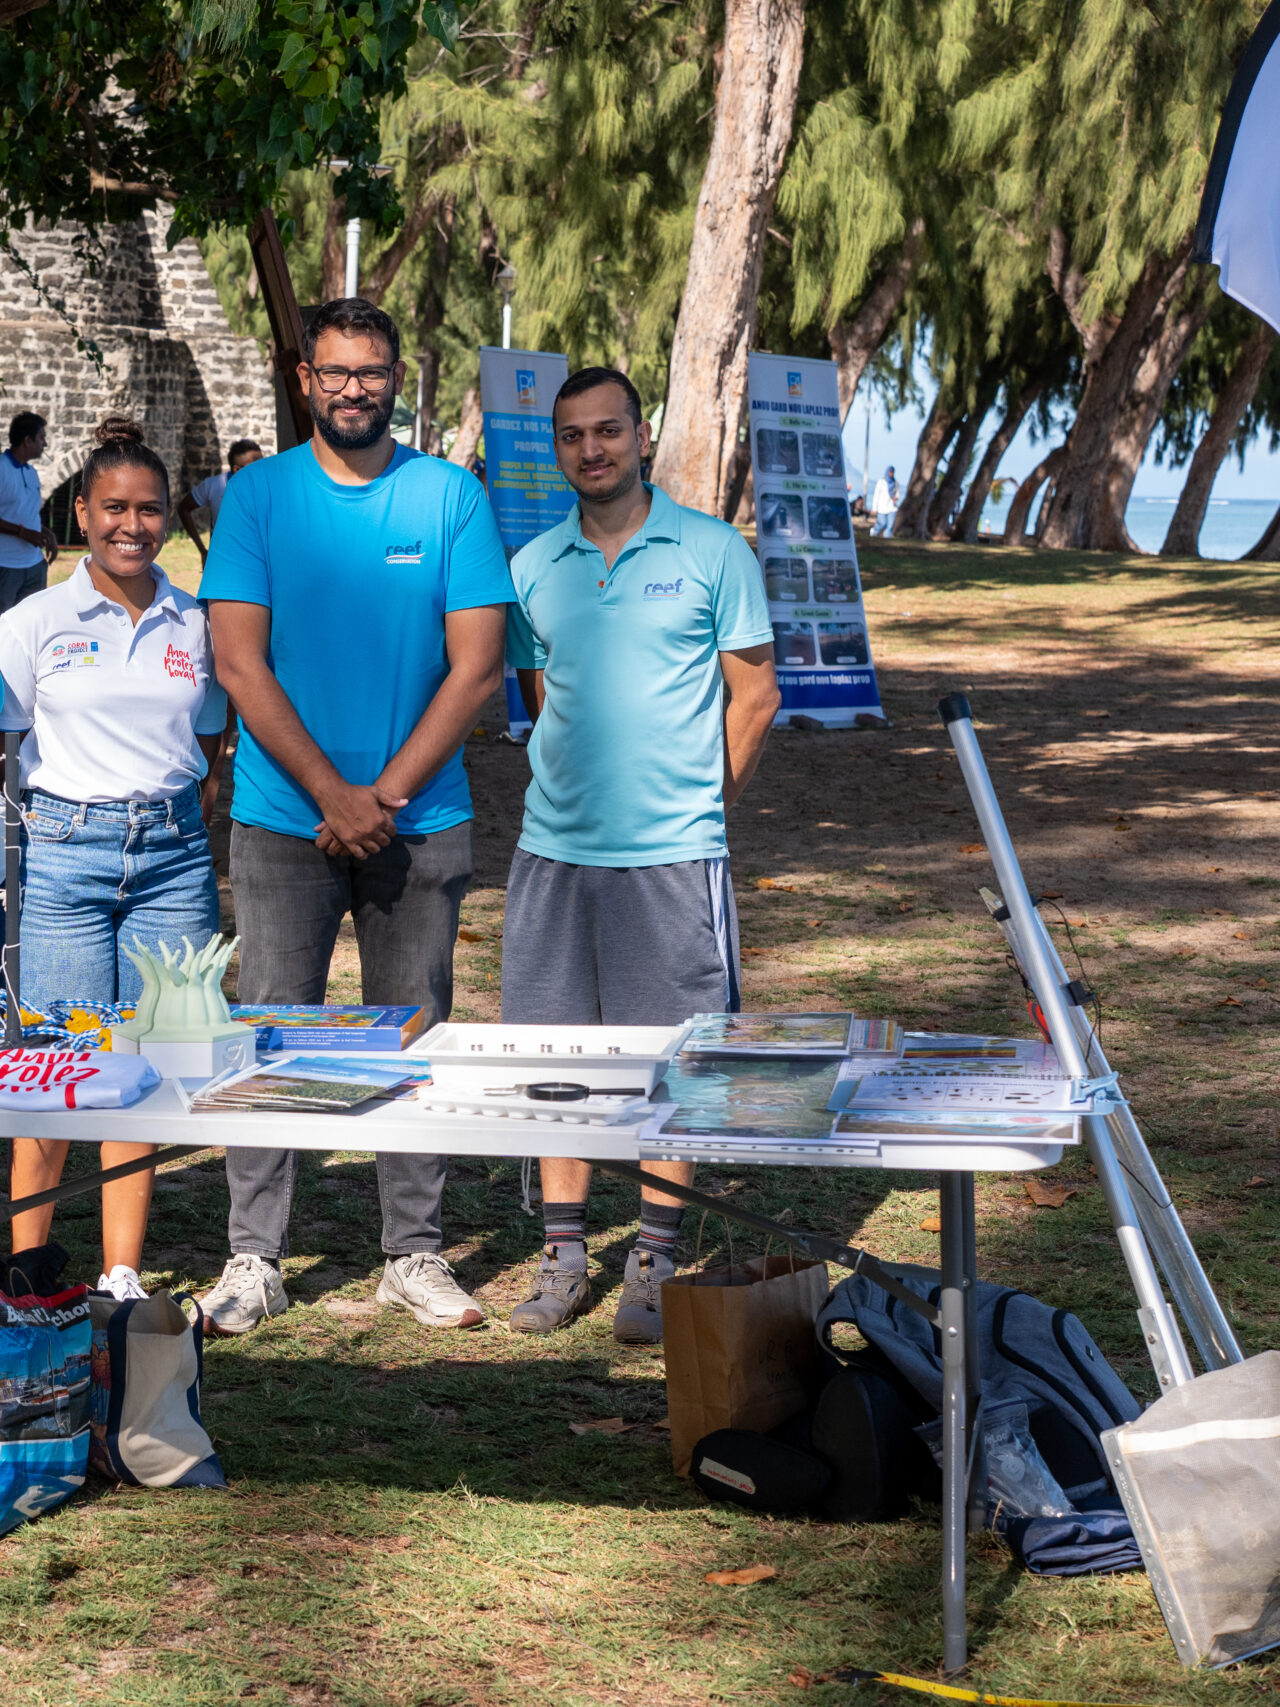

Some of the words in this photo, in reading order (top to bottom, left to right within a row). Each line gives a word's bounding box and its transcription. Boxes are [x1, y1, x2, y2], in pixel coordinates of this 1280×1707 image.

[385, 540, 423, 557] reef
[643, 578, 684, 594] reef
[167, 643, 190, 660] Anou
[52, 659, 71, 670] reef
